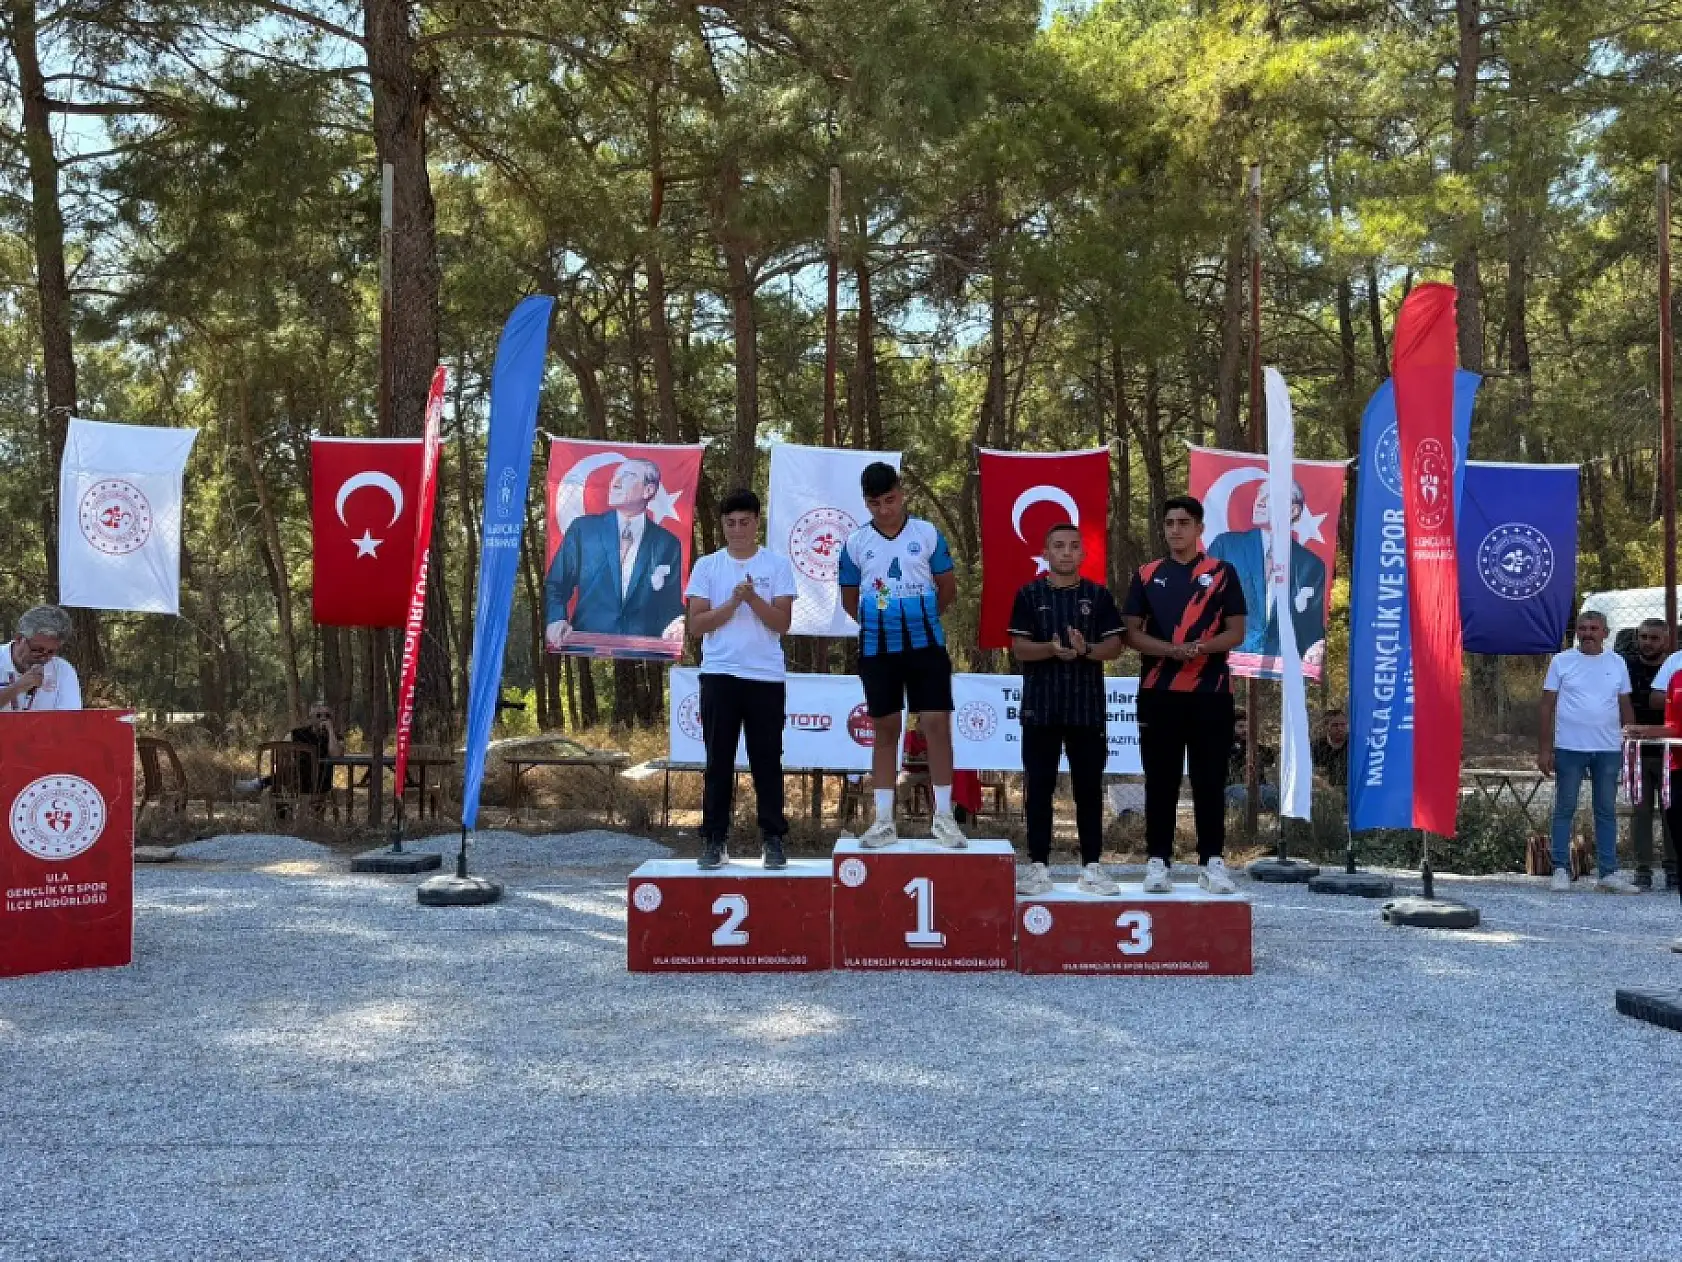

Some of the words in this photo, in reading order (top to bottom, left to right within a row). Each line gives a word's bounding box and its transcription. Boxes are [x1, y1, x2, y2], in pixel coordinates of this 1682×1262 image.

[1380, 508, 1405, 568] SPOR
[1377, 573, 1404, 601] VE
[1370, 606, 1402, 702] GENÇLİK
[784, 713, 832, 728] TOTO
[1365, 706, 1392, 786] MUĞLA
[6, 884, 58, 898] GENÇLİK
[60, 884, 74, 894] VE
[76, 882, 108, 893] SPOR
[45, 872, 69, 883] ULA
[7, 899, 32, 911] İLÇE
[34, 892, 107, 908] MÜDÜRLÜĞÜ
[712, 894, 749, 946] 2
[903, 877, 946, 947] 1
[1116, 910, 1153, 955] 3
